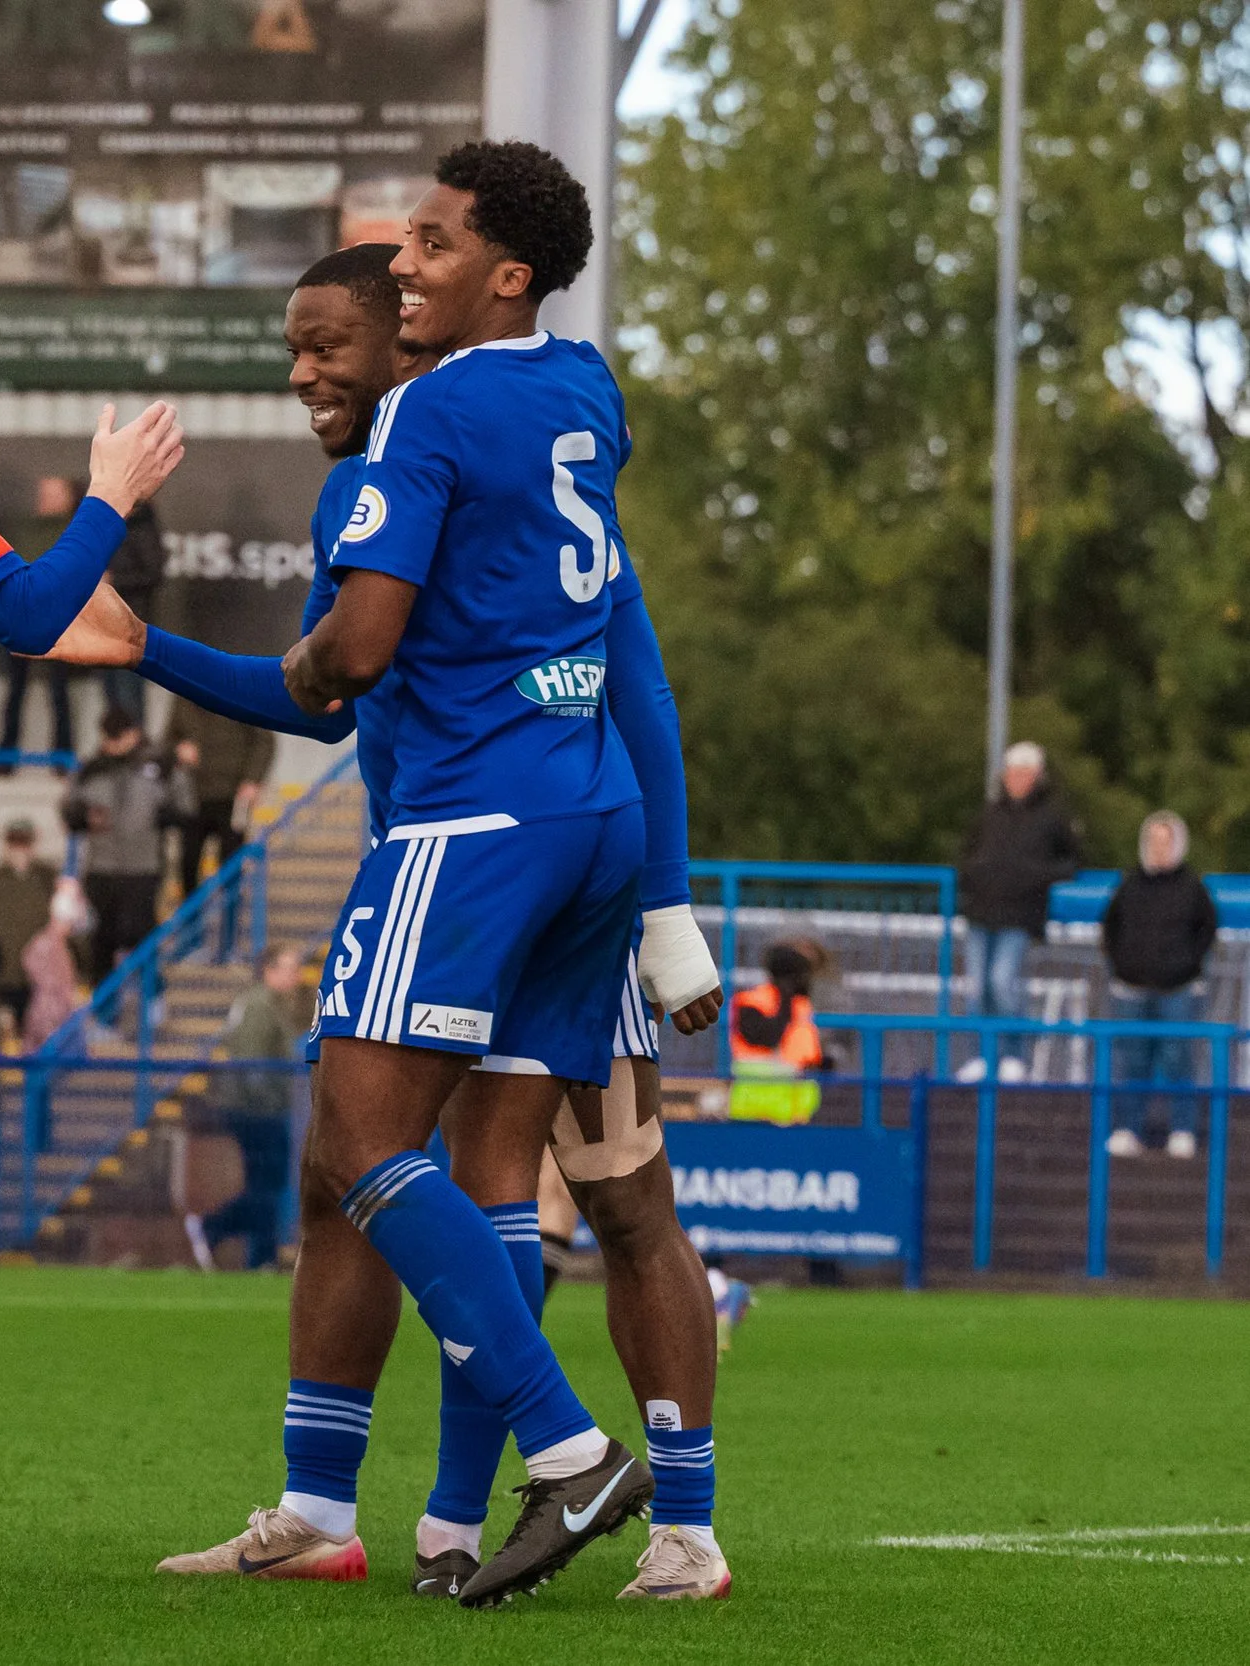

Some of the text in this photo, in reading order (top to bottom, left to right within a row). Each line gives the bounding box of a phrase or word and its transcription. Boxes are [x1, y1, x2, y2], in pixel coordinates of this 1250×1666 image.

[551, 430, 607, 603] 5
[333, 906, 375, 981] 5
[450, 1018, 478, 1028] AZTEK
